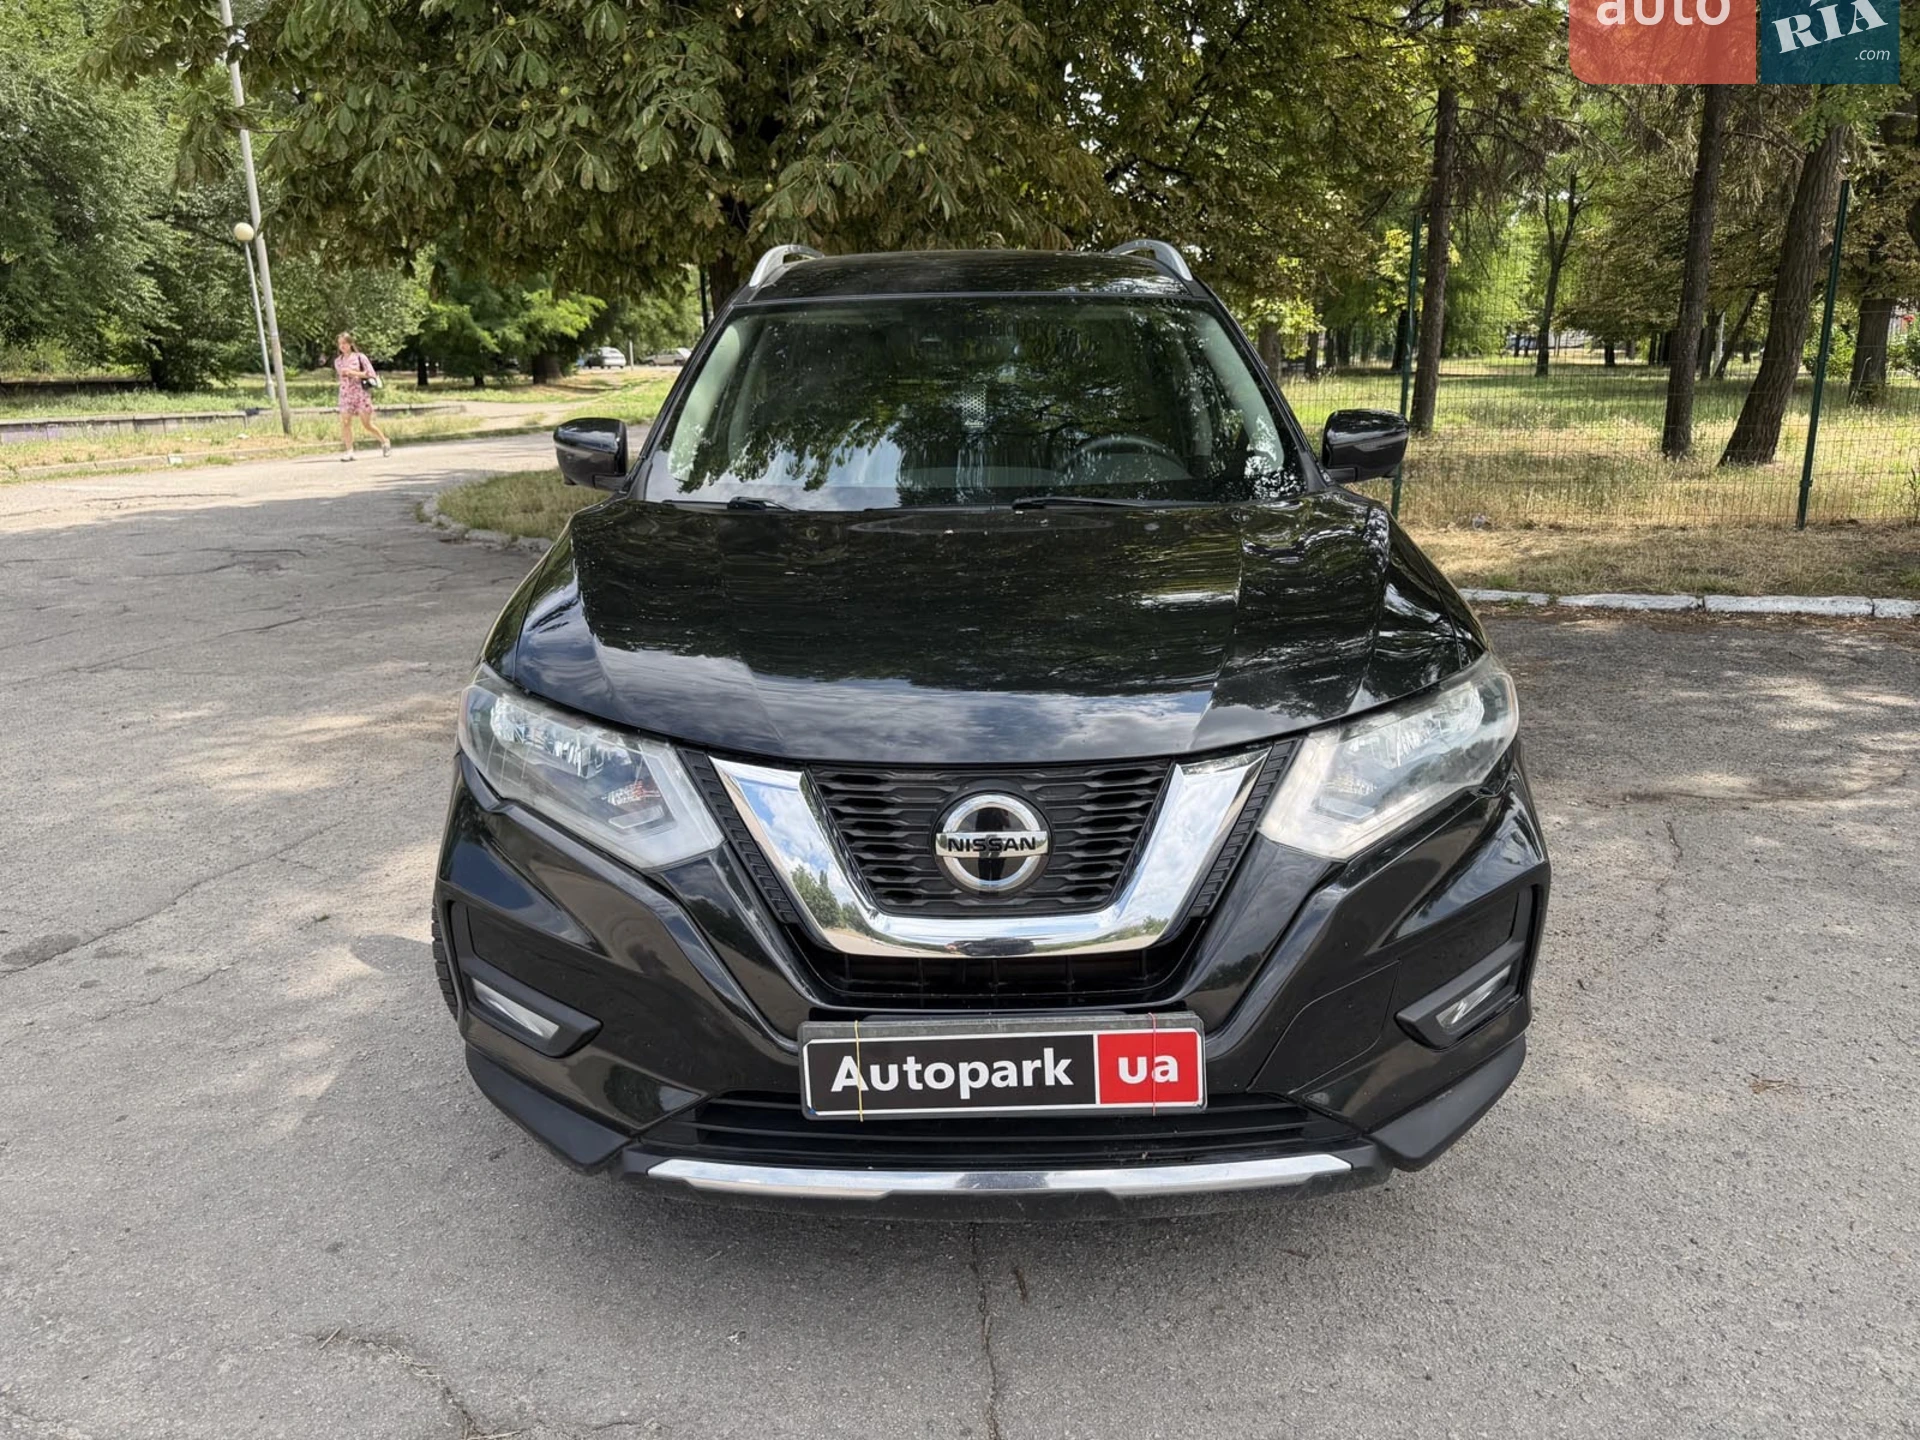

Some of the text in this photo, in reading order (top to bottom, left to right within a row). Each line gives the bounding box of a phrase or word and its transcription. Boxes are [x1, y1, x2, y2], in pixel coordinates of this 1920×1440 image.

[948, 836, 1036, 852] NISSAN
[831, 1047, 1178, 1100] Autopark ua
